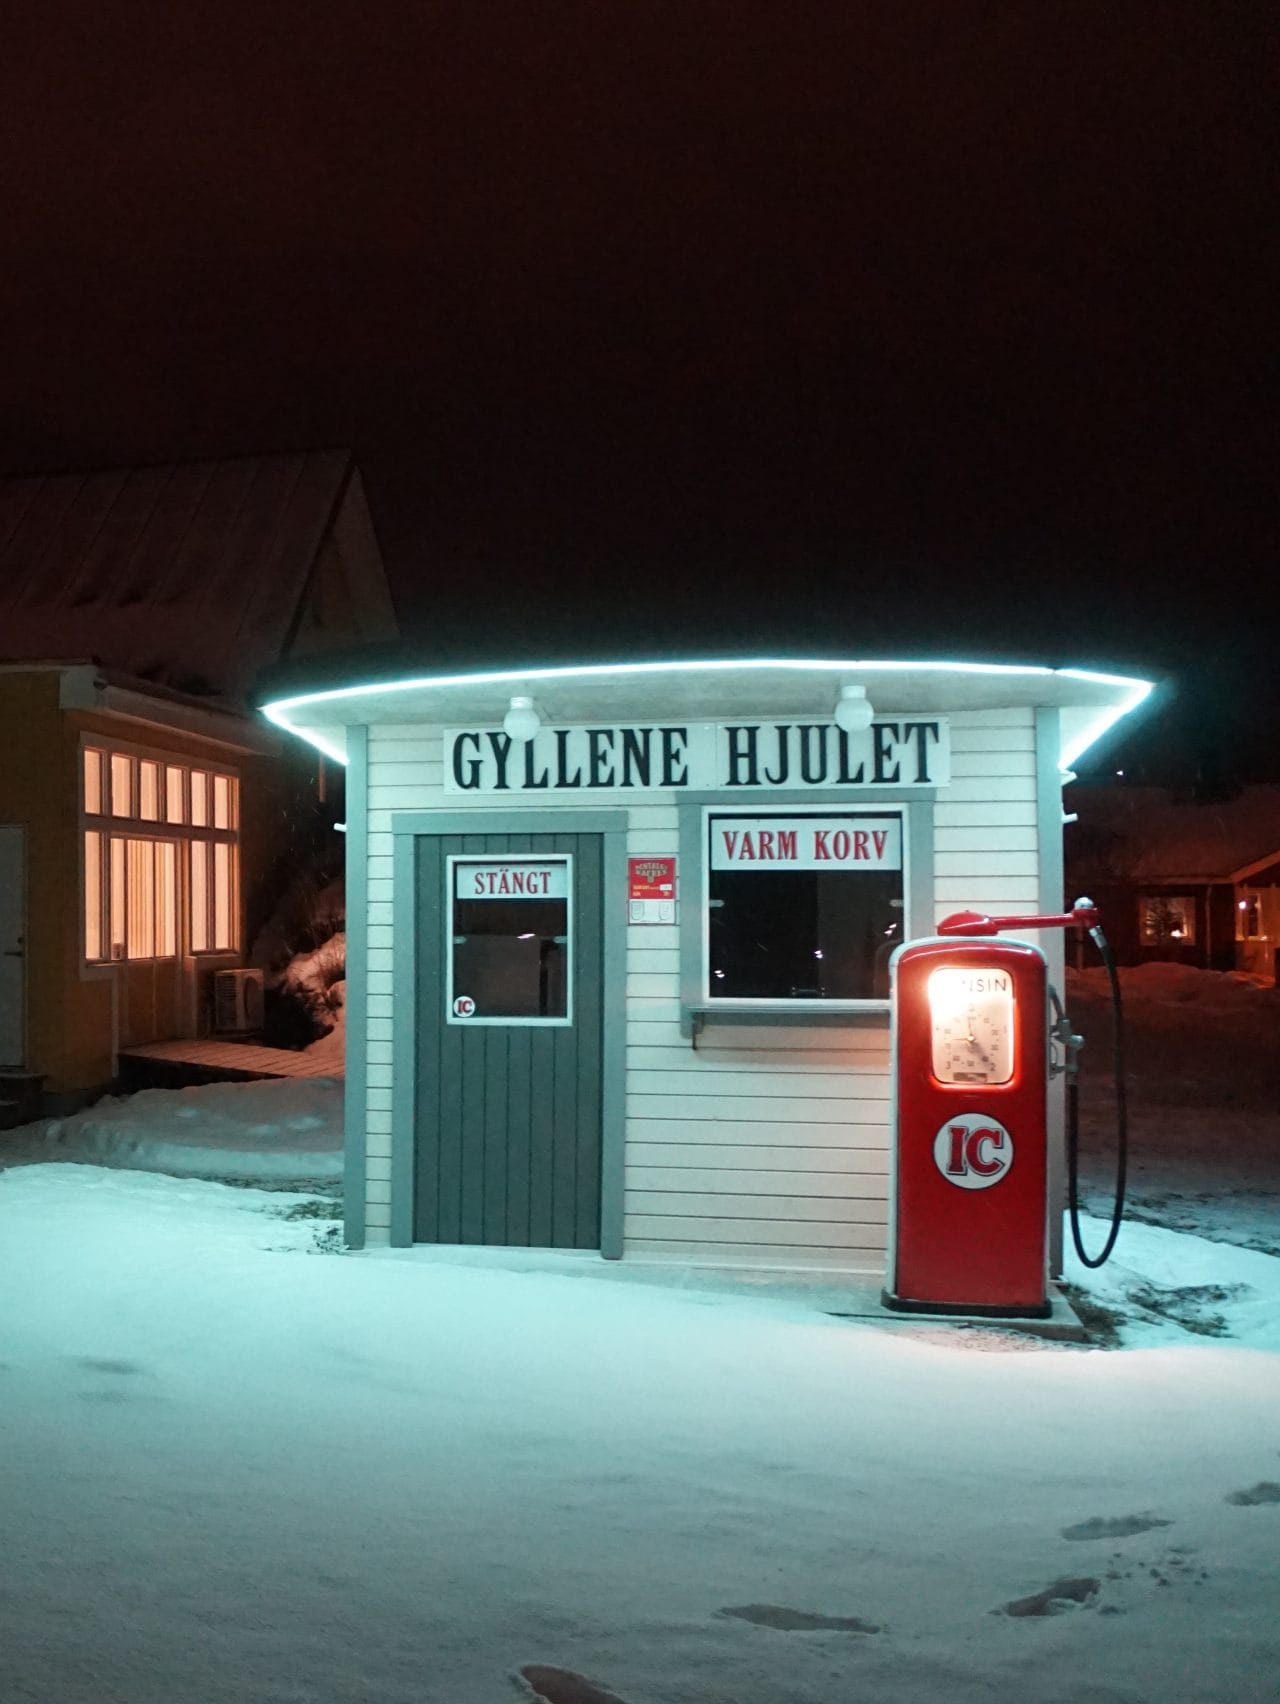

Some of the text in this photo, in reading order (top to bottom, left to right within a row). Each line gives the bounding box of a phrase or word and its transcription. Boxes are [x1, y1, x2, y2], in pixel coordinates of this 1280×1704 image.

[453, 722, 939, 789] GYLLENE HJULET
[722, 830, 888, 860] VARM KORV
[474, 868, 551, 894] STÄNGT
[946, 1125, 1005, 1177] IC
